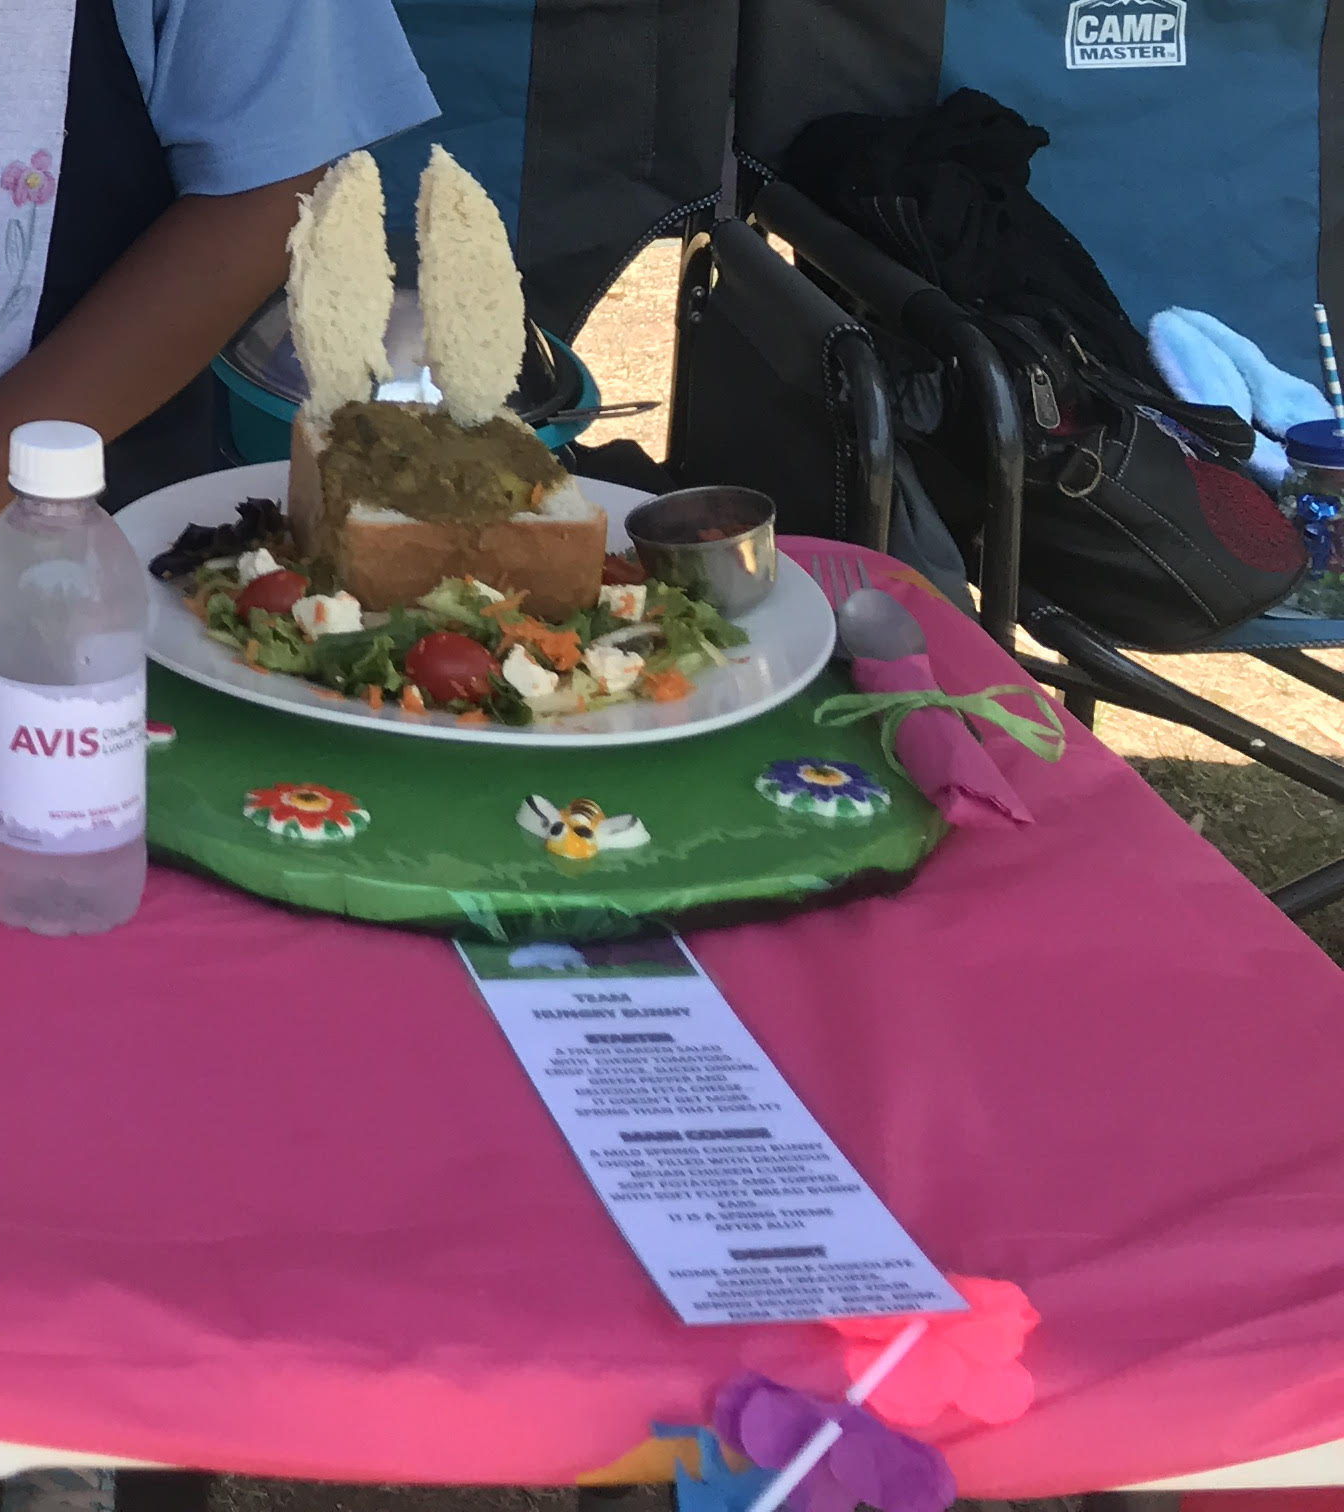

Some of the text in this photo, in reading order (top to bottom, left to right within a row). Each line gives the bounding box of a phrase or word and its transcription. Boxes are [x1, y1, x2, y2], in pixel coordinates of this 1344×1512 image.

[1076, 13, 1176, 44] CAMP
[1080, 46, 1166, 60] MASTER
[9, 725, 100, 758] AVIS
[695, 1074, 728, 1082] AND
[575, 1107, 629, 1117] SPRING
[632, 1105, 673, 1115] THAN
[676, 1104, 714, 1113] THAT
[707, 1155, 749, 1165] WITH
